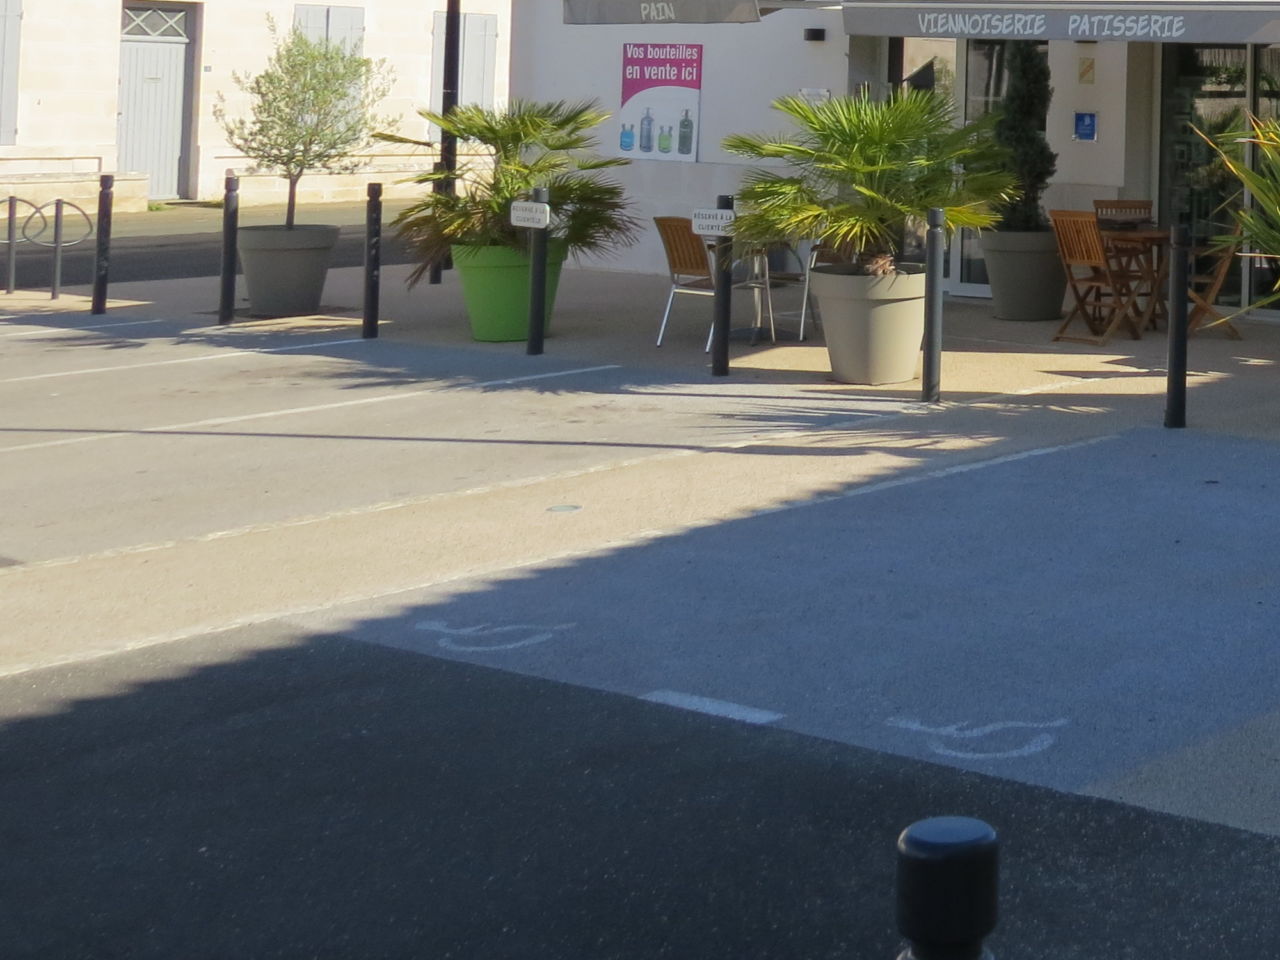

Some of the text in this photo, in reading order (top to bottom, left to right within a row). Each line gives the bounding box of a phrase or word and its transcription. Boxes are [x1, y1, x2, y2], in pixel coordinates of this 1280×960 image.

[640, 2, 676, 20] PAIN
[918, 13, 1186, 38] VIENNOISERIE PATISSERIE
[626, 44, 698, 60] Vos bouteilles
[626, 63, 697, 80] en vente ici
